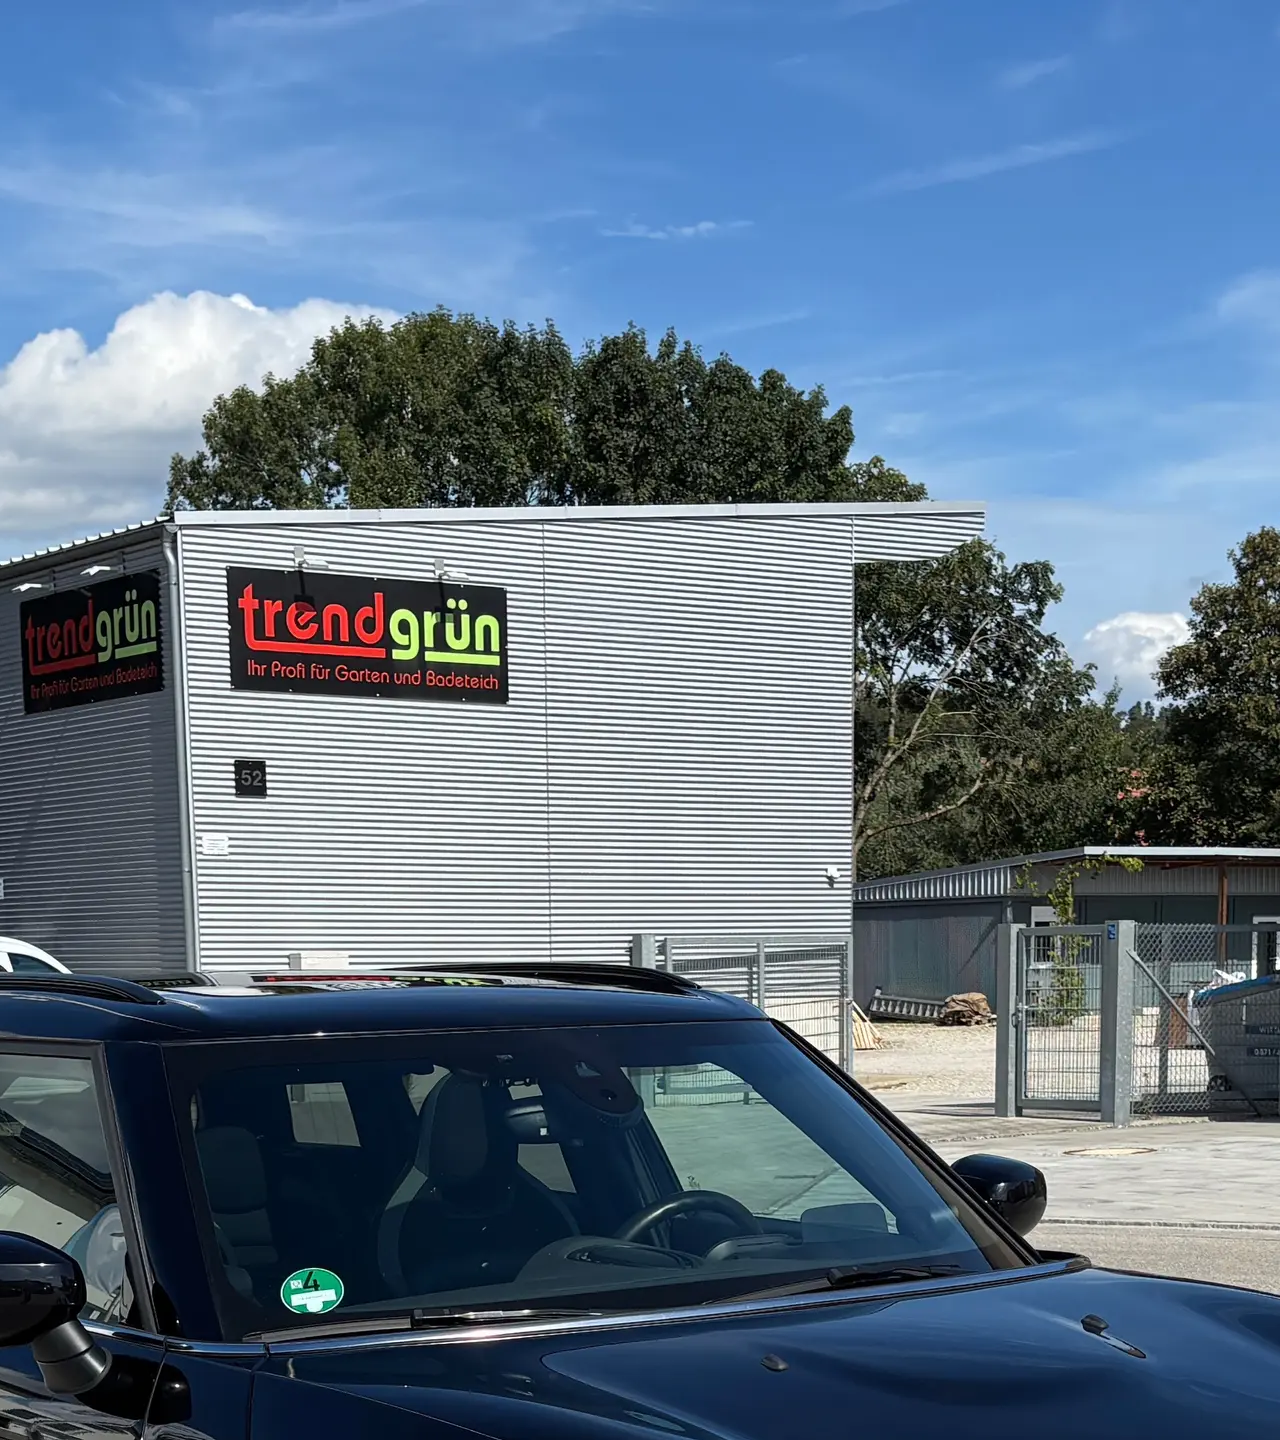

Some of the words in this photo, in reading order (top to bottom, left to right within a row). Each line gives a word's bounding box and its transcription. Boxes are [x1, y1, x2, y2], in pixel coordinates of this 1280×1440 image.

[71, 676, 99, 693] Garten
[100, 671, 115, 687] und
[247, 659, 267, 677] Ihr
[271, 660, 306, 679] Profi
[310, 664, 331, 680] für
[334, 664, 390, 684] Garten
[394, 670, 421, 686] und
[426, 670, 499, 691] Badeteich
[240, 769, 263, 786] 52
[302, 1270, 321, 1291] 4
